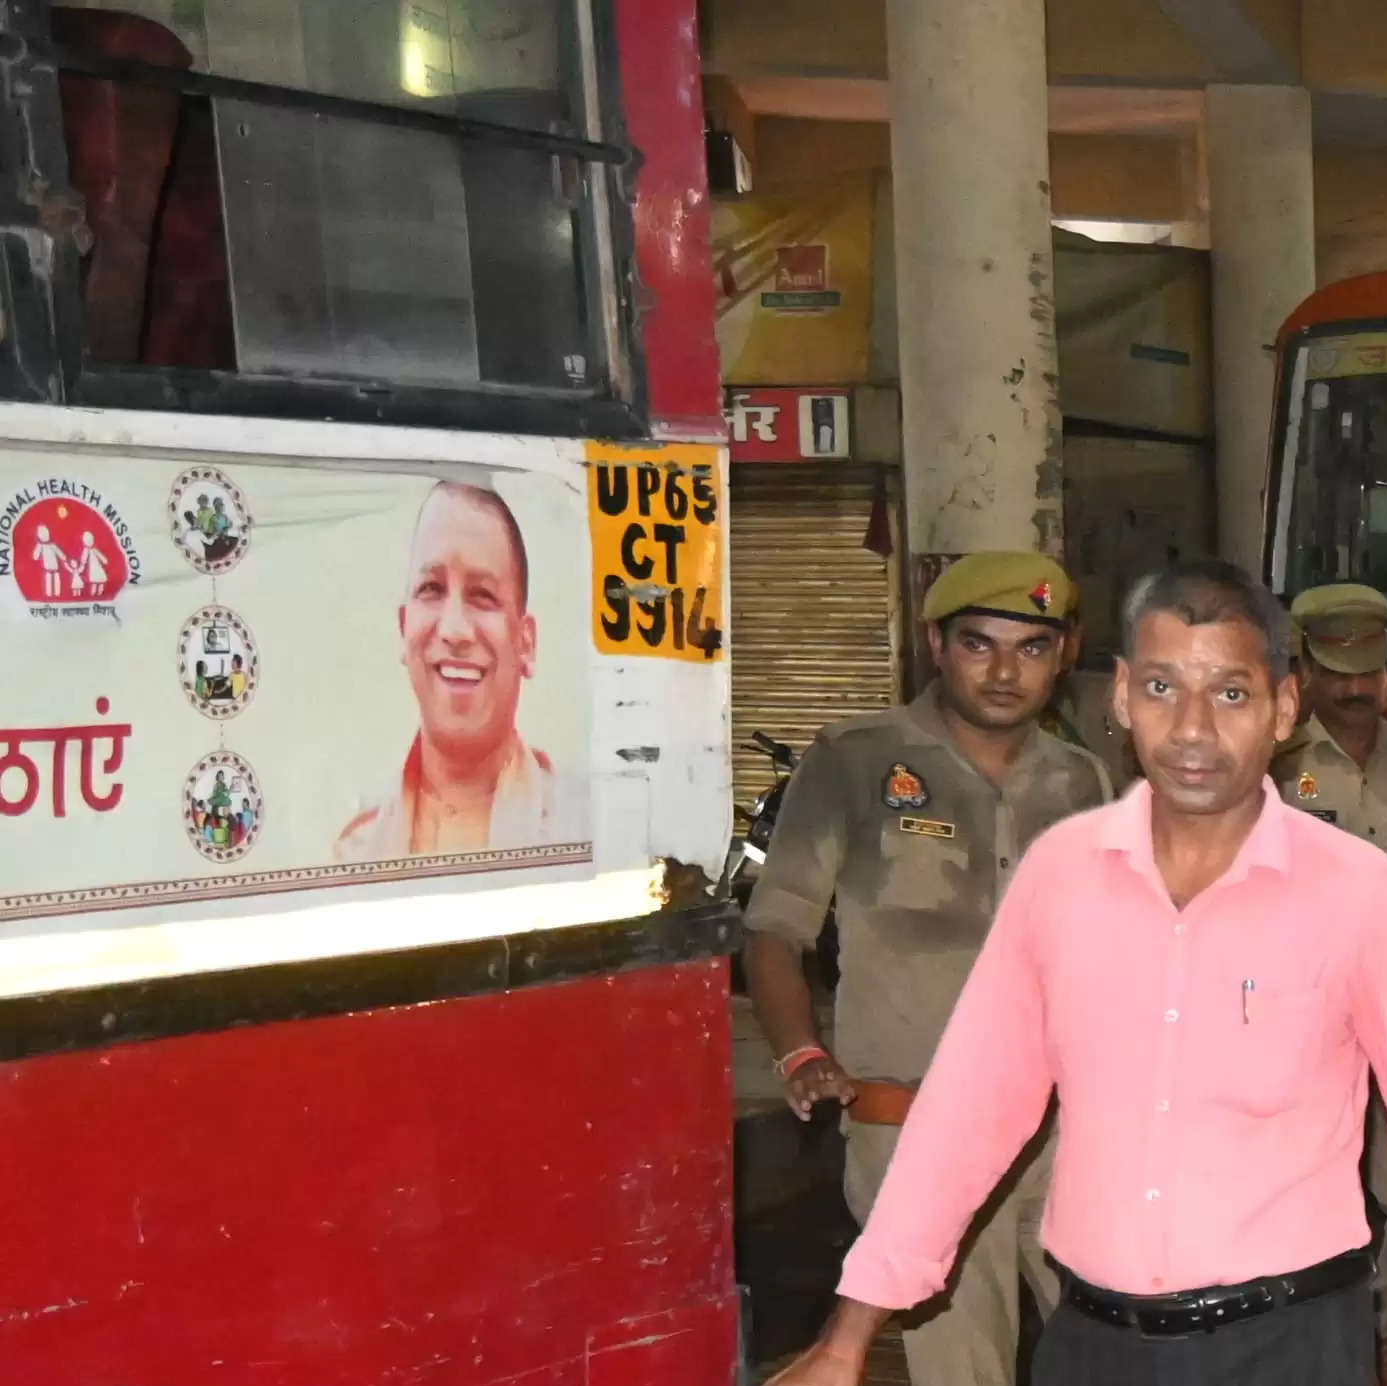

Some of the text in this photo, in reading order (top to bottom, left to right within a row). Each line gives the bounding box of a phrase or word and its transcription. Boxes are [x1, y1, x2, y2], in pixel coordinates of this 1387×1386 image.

[597, 461, 717, 526] UP65
[0, 478, 142, 585] NATIONAL HEALTH MISSION
[621, 522, 685, 585] CT
